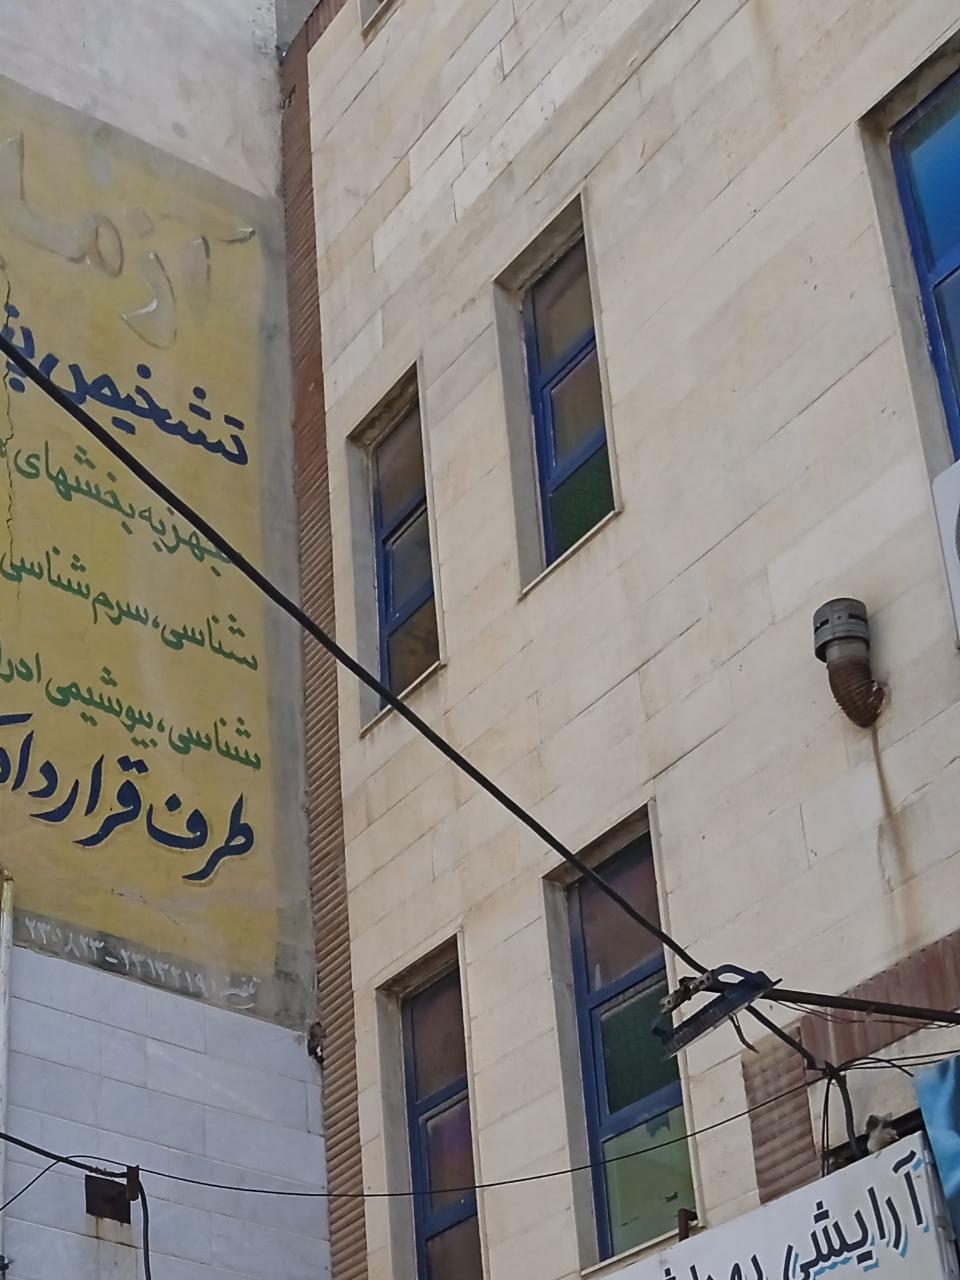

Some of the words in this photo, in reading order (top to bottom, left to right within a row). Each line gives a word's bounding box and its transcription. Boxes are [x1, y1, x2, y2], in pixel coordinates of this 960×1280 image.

[40, 354, 249, 466] تشخیص
[158, 507, 235, 578] جهز
[91, 591, 149, 626] سرم
[44, 666, 159, 751] بیوشیمی
[145, 791, 255, 881] طرف
